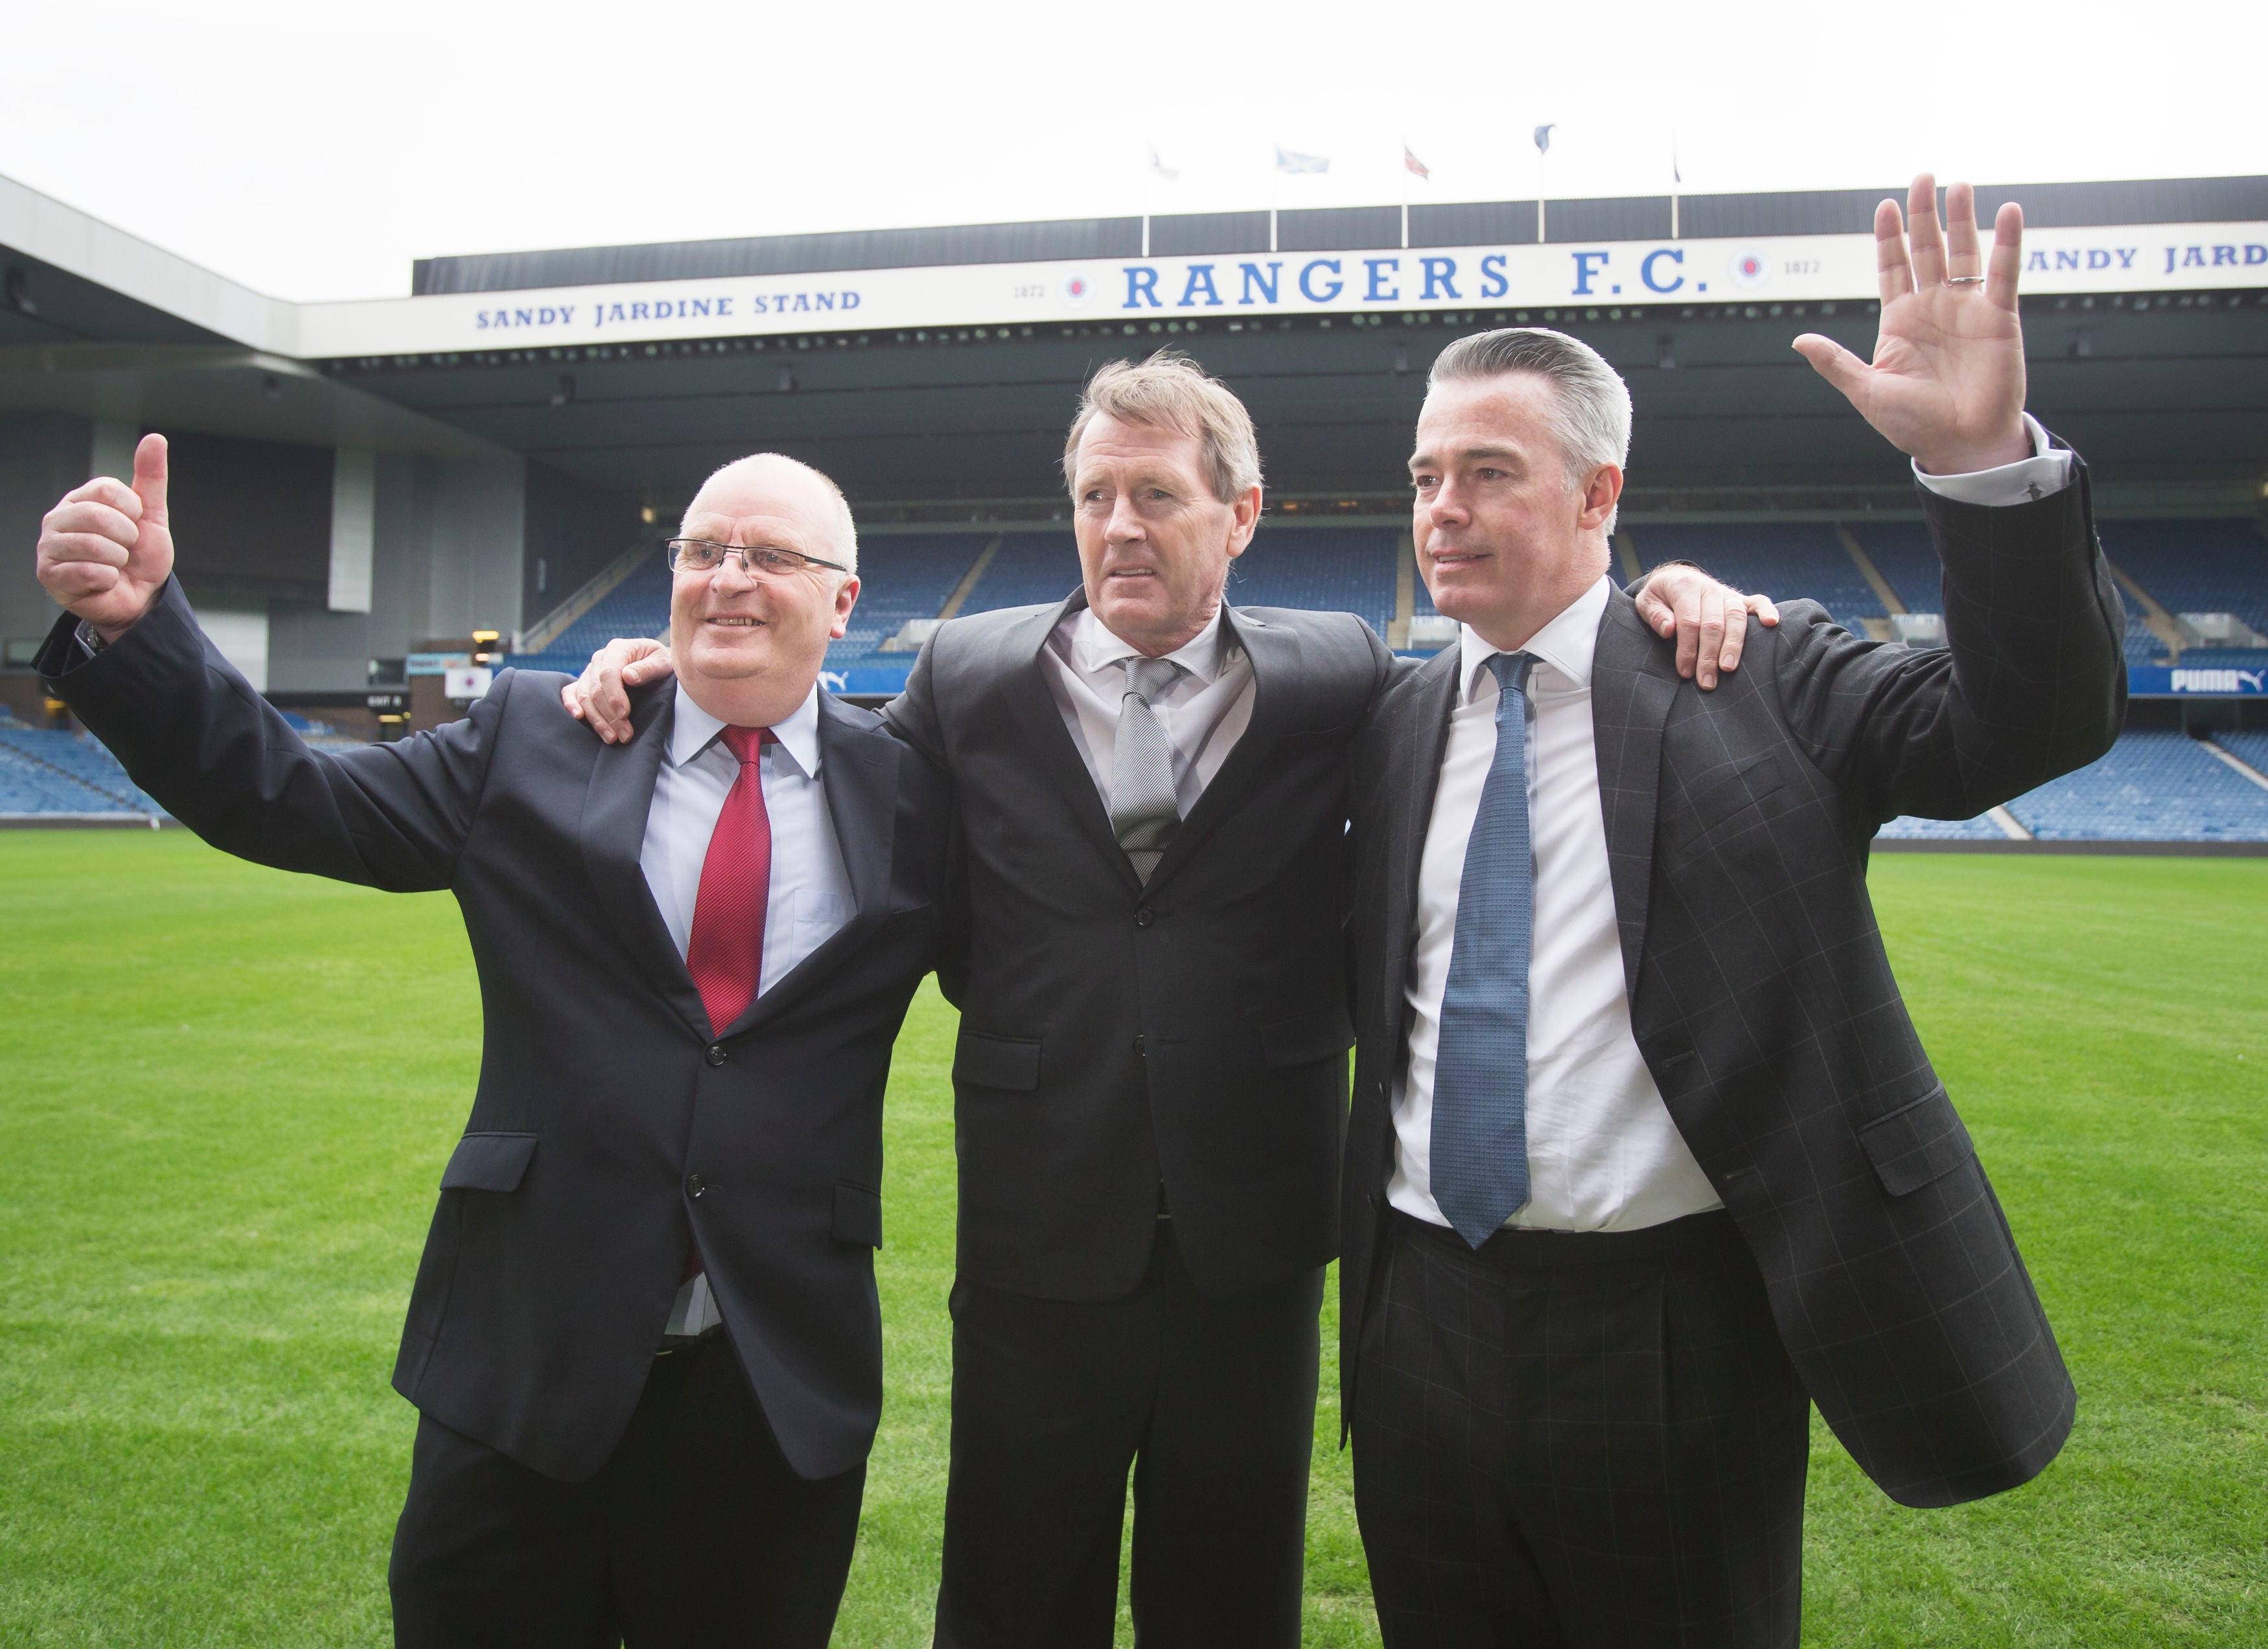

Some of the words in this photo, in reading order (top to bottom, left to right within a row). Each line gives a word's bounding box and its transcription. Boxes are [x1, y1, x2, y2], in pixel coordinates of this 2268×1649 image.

[1785, 259, 1822, 275] 1872
[2028, 248, 2137, 270] ANDY
[2165, 244, 2268, 274] JARD
[1122, 254, 1509, 309] RANGERS
[1571, 248, 1707, 296] F.C.
[1013, 285, 1045, 299] 1872
[477, 305, 575, 328] SANDY
[595, 297, 733, 327] JARDINE
[754, 291, 861, 313] STAND
[2171, 670, 2239, 692] PUMA
